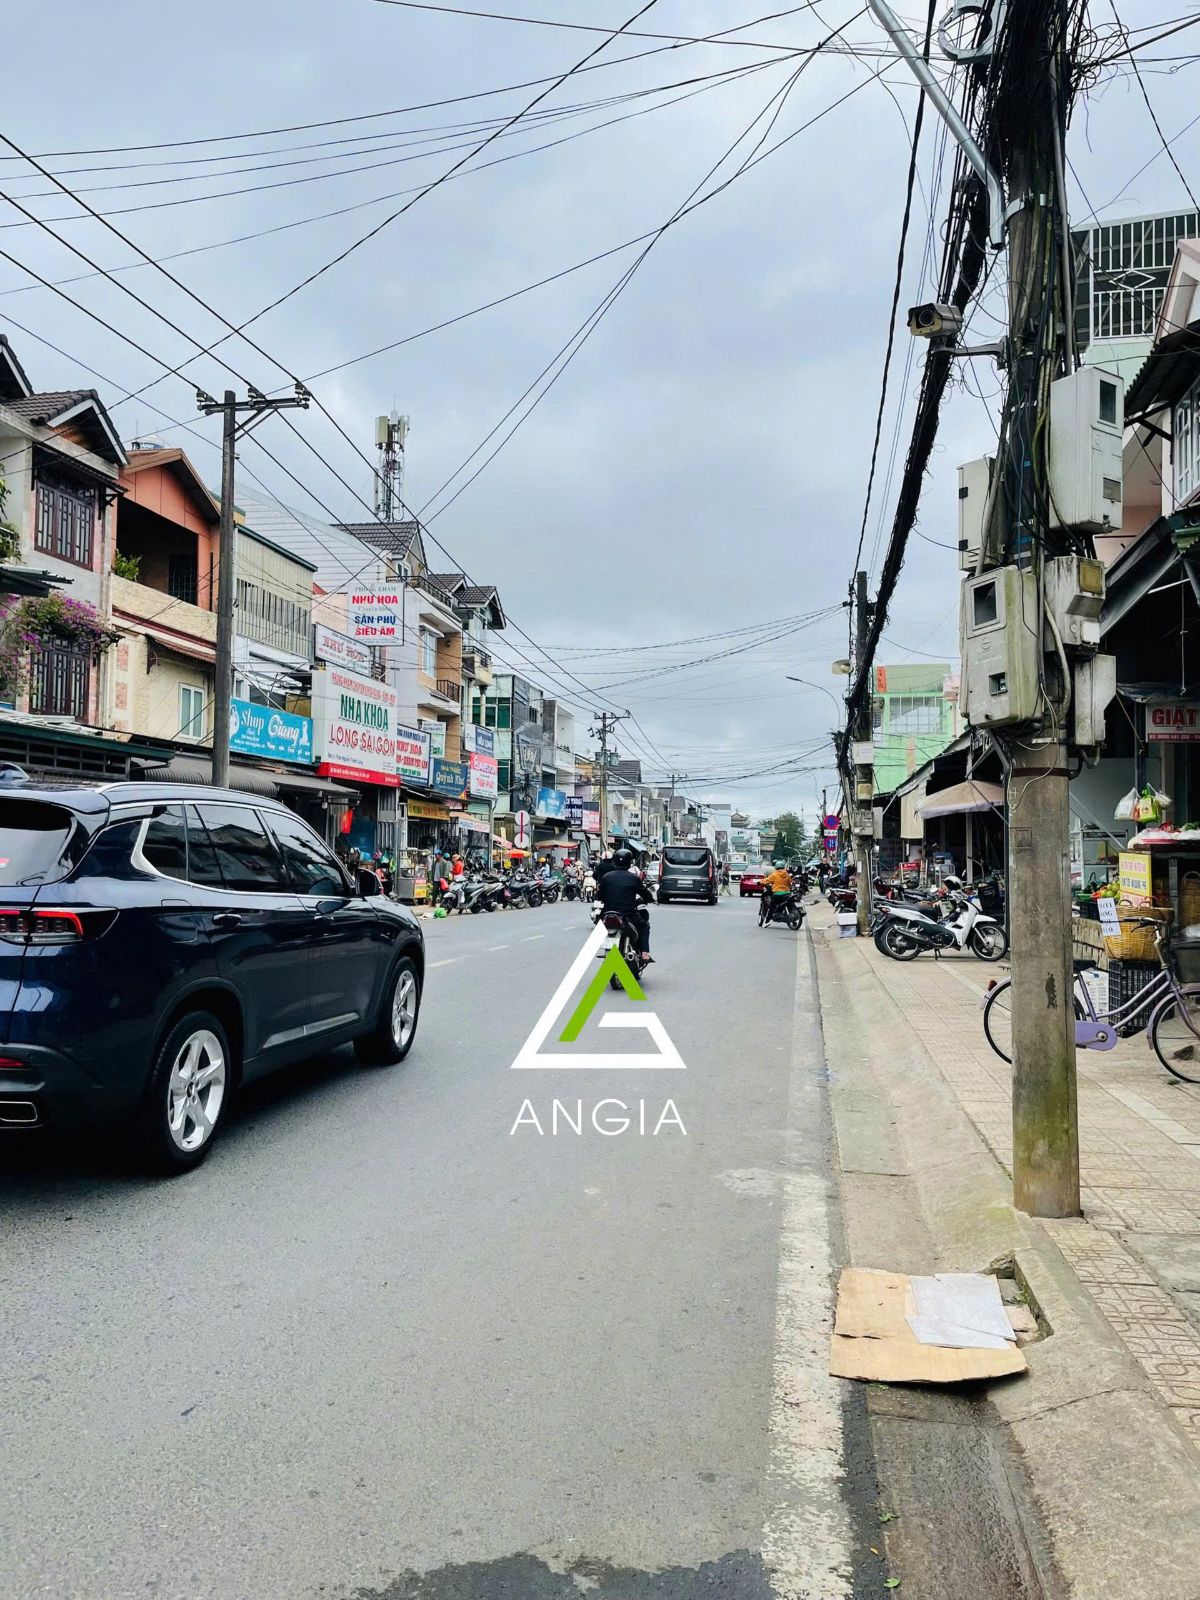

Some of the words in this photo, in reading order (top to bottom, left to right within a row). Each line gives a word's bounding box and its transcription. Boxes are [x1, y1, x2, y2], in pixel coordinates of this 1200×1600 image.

[377, 595, 398, 604] HOA
[341, 693, 362, 723] NHA
[365, 701, 389, 731] KHOA
[240, 708, 265, 735] Shop
[268, 714, 300, 748] Giang
[330, 723, 358, 748] LONG
